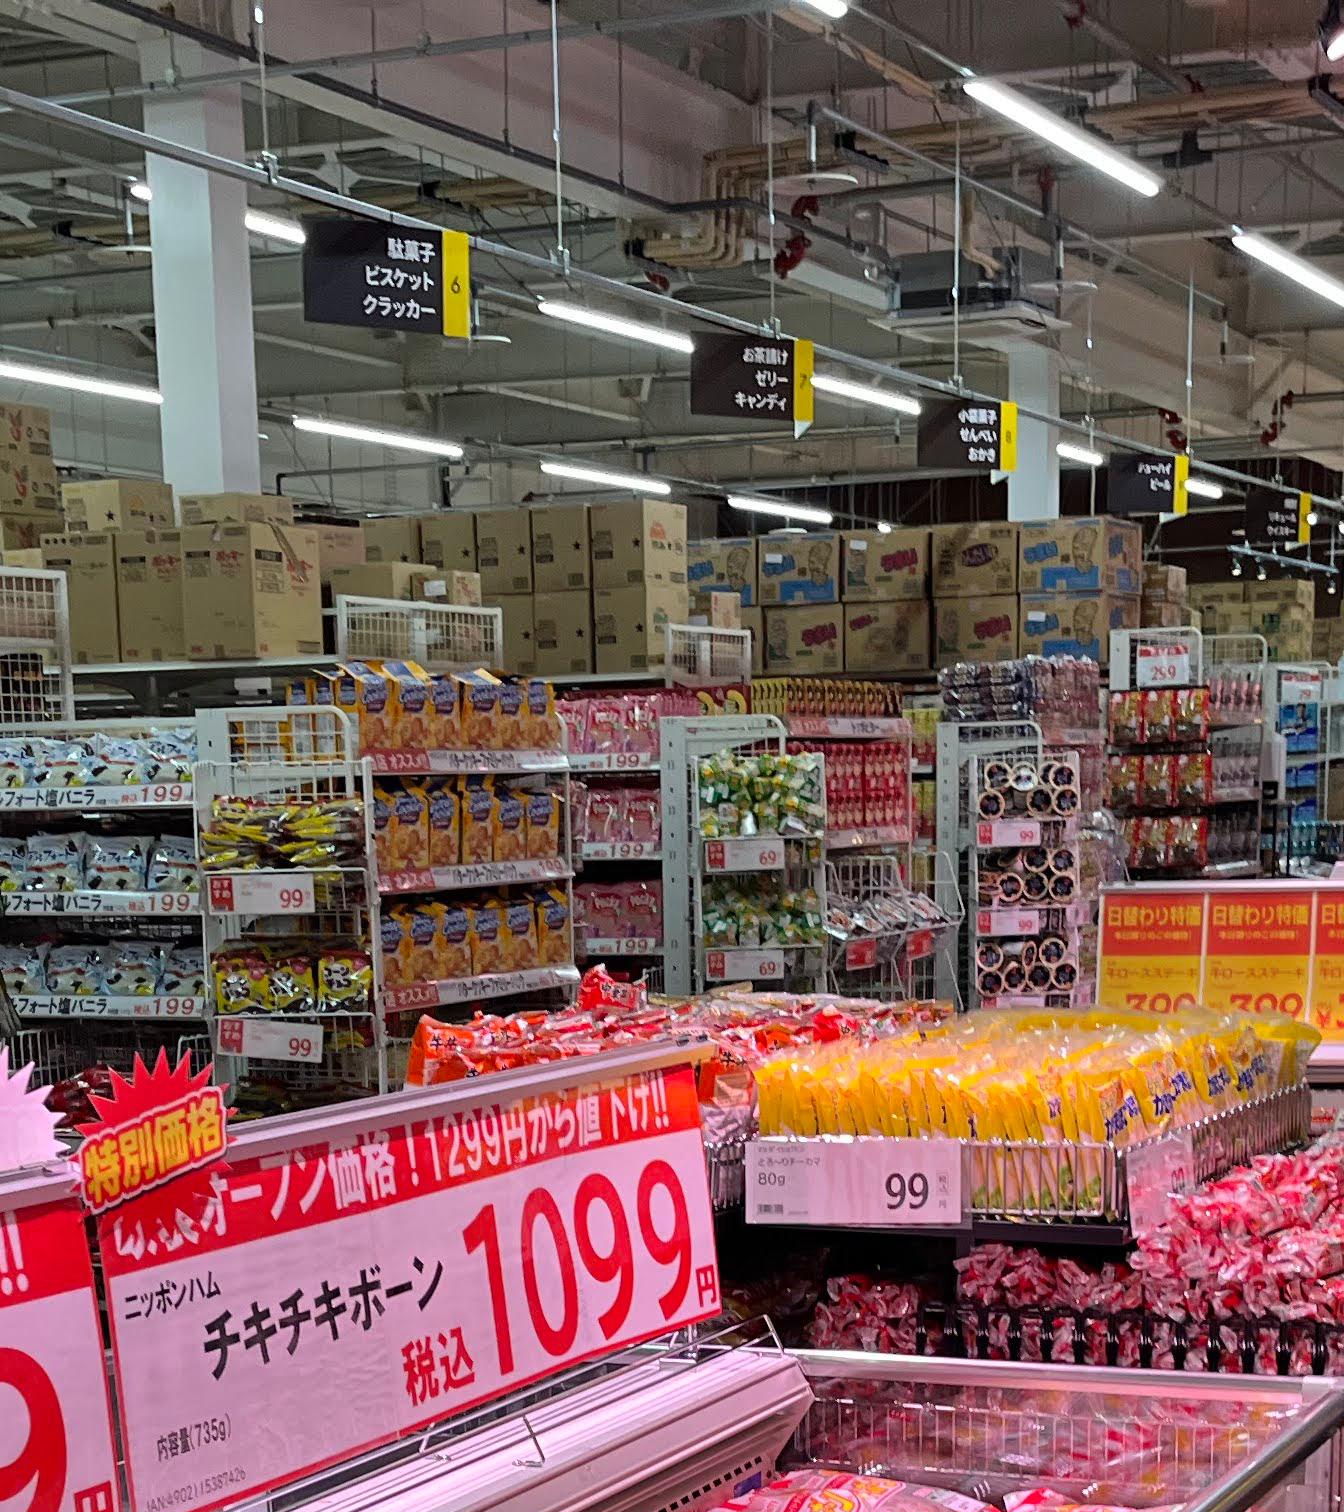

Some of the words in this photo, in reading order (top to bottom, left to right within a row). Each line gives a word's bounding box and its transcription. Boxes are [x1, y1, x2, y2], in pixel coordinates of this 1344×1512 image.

[365, 265, 434, 291] ビスケット
[451, 275, 461, 294] 6
[363, 293, 436, 320] クラッカー
[755, 371, 788, 388] ゼリー
[734, 391, 787, 412] キャンディ
[606, 753, 641, 769] 199
[141, 784, 184, 804] 199
[609, 843, 644, 859] 199
[758, 850, 778, 867] 69
[147, 893, 191, 913] 199
[279, 888, 304, 910] 99
[1108, 904, 1202, 926] 日替わり特価
[1212, 904, 1309, 926] 日替わり特価
[615, 939, 649, 954] 199
[758, 961, 778, 977] 69
[154, 997, 196, 1016] 199
[288, 1037, 313, 1057] 99
[84, 1090, 222, 1200] 特別価格
[757, 1171, 786, 1187] 80g
[884, 1171, 930, 1211] 99
[462, 1159, 693, 1376] 1099
[123, 1270, 222, 1321] ニッポンハム
[202, 1254, 444, 1381] チキチキボーン
[400, 1327, 477, 1408] 税込
[156, 1412, 233, 1462] 内容量(735g)
